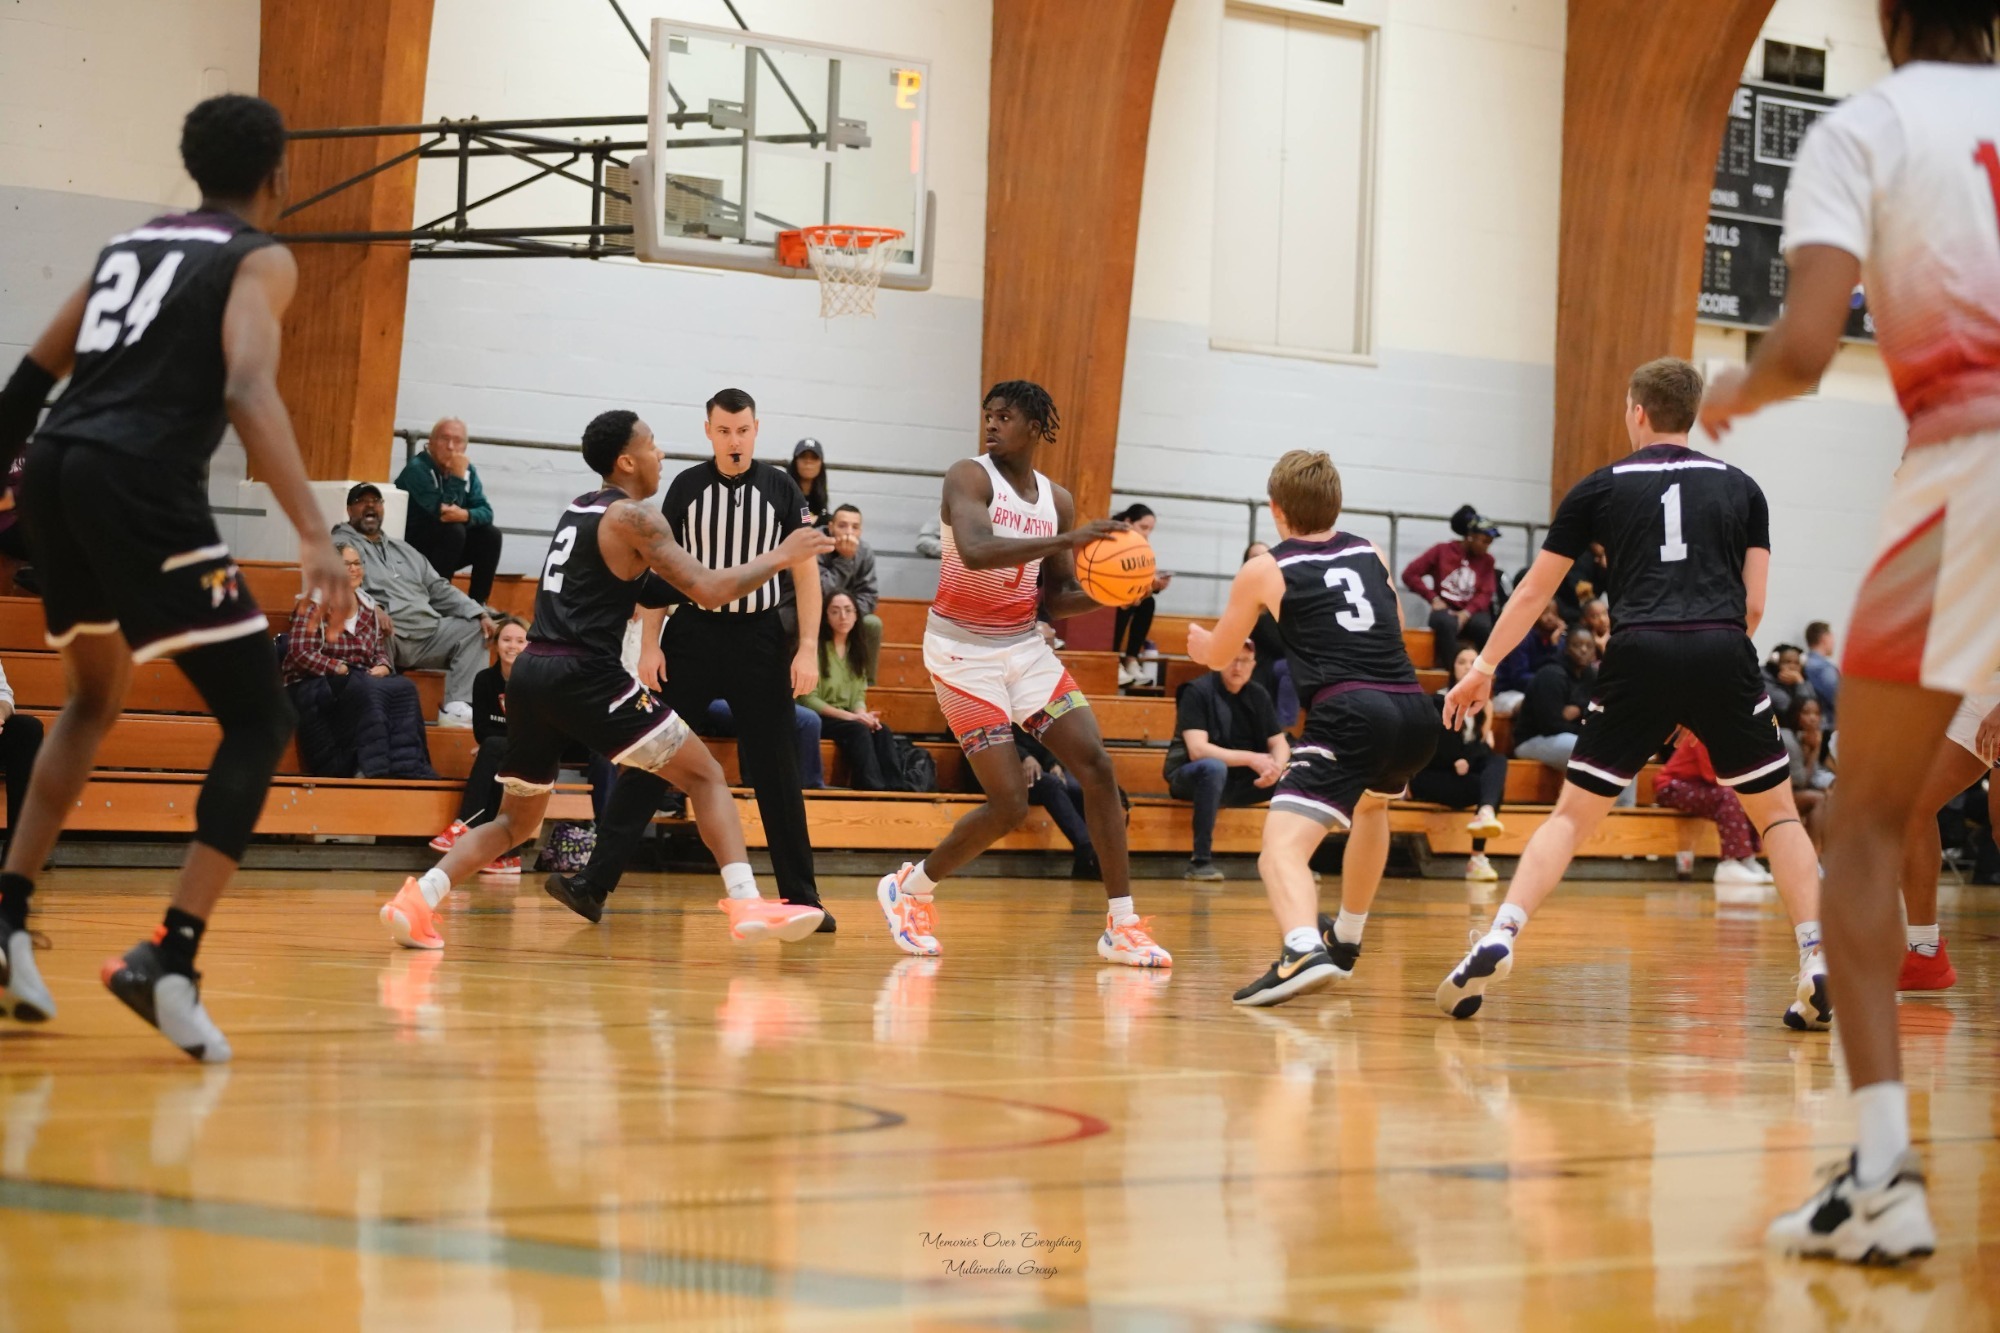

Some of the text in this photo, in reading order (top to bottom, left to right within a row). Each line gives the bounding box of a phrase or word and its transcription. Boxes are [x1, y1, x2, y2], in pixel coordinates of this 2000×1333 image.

[1704, 223, 1740, 247] OULS
[76, 250, 185, 353] 24
[993, 507, 1053, 538] BRYN ATHYN
[1660, 482, 1687, 562] 1
[542, 525, 577, 594] 2
[1323, 567, 1375, 632] 3
